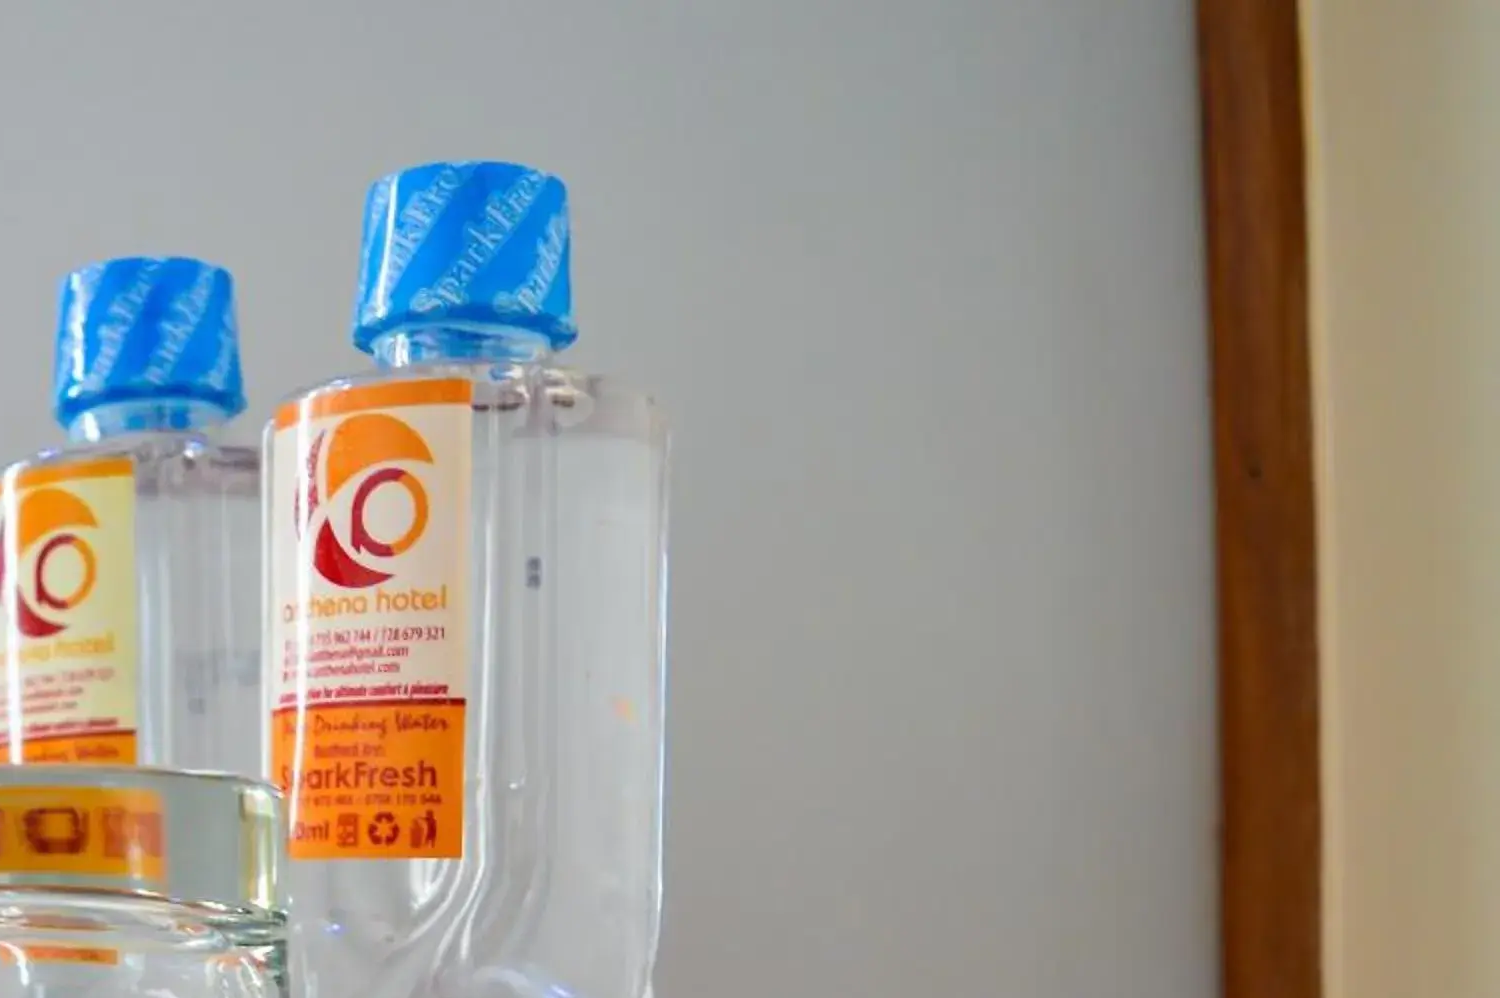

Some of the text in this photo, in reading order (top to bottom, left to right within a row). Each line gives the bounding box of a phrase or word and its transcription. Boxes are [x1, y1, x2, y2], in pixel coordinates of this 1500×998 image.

[283, 584, 448, 622] ahena hotel
[402, 625, 423, 641] 679
[426, 625, 445, 641] 321
[395, 711, 448, 733] Water
